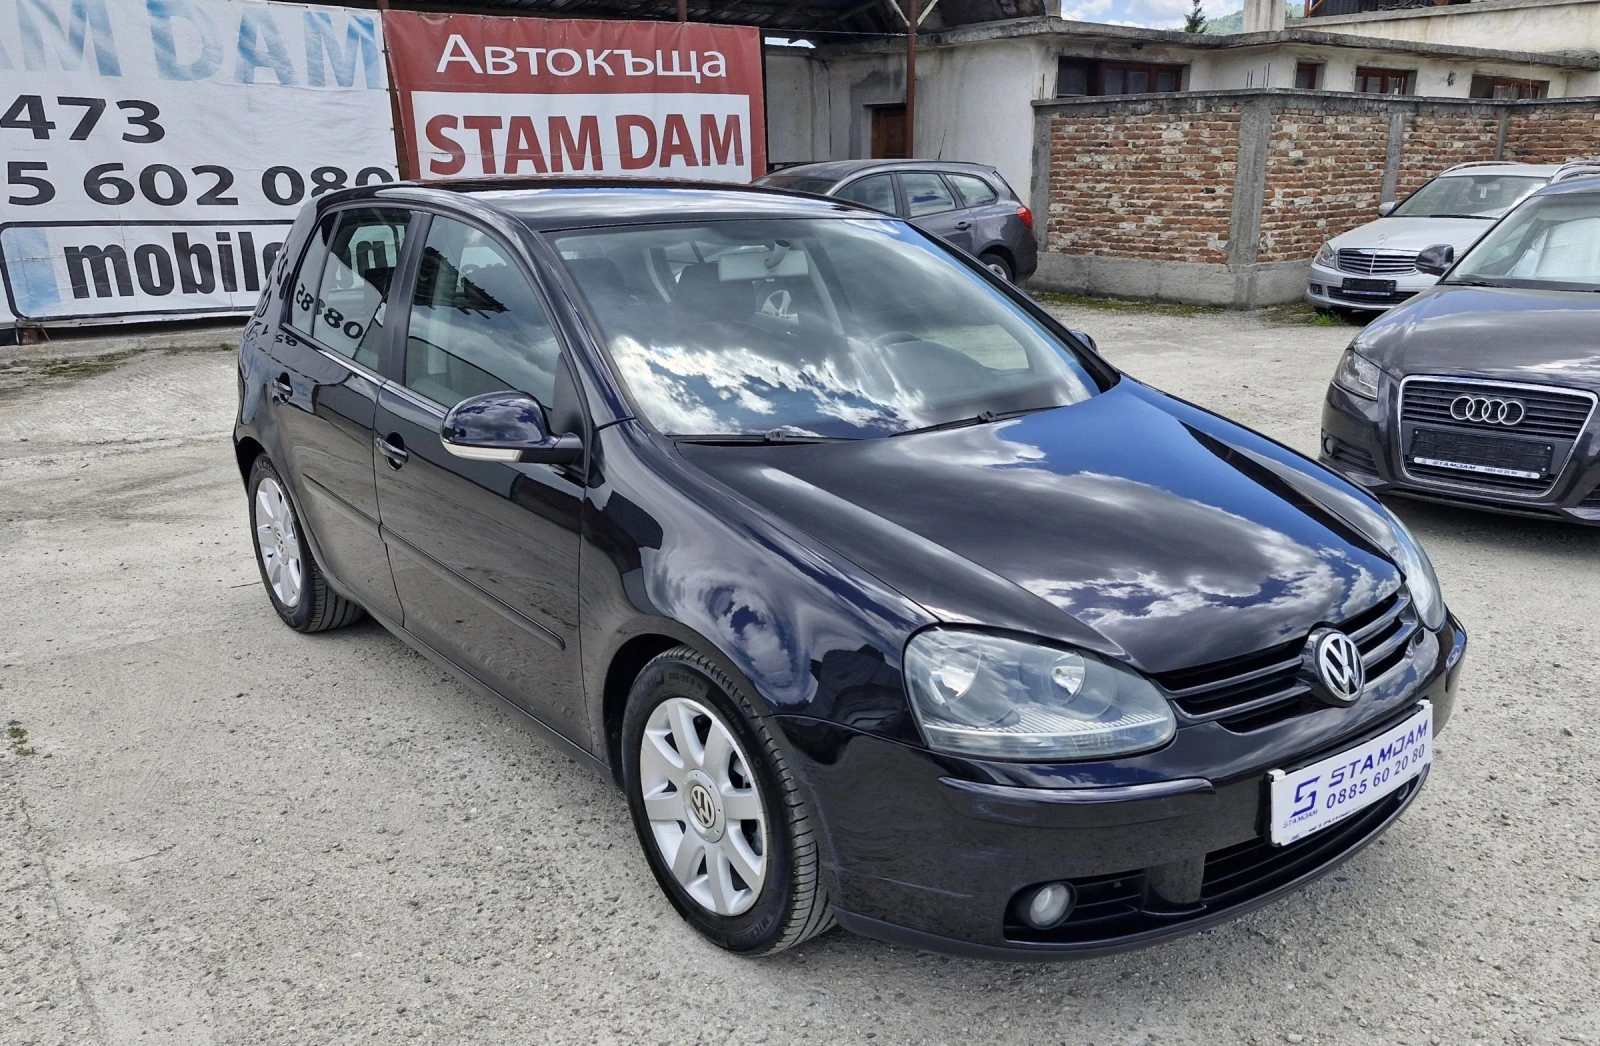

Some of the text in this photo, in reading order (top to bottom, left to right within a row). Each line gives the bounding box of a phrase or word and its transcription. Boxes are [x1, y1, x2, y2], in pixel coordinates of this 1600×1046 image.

[0, 0, 382, 90] M DAM
[436, 33, 727, 84] Автокъща
[0, 95, 166, 144] 473
[425, 113, 744, 176] STAM DAM
[7, 161, 56, 206] 5
[83, 162, 239, 206] 602
[1326, 743, 1425, 809] 0885 60 20 80
